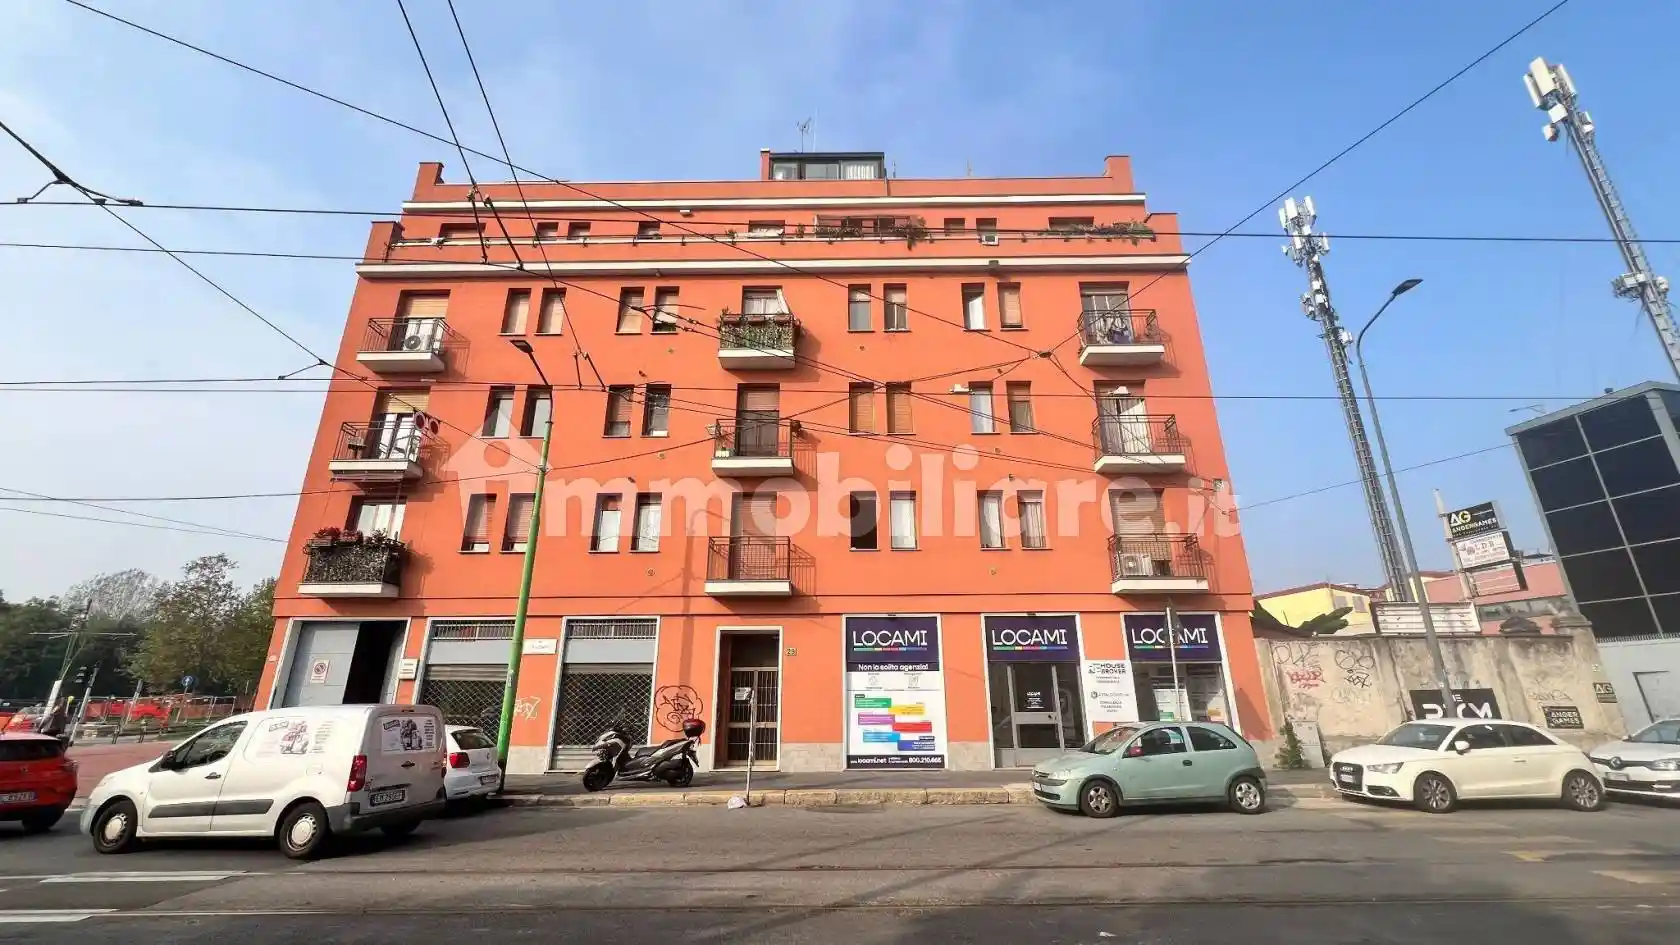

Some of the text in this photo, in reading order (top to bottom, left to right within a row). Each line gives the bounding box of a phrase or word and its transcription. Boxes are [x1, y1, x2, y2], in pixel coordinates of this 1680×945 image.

[1450, 510, 1471, 527] AG
[852, 630, 928, 646] LOCAMI
[991, 629, 1068, 645] LOCAMI
[858, 663, 872, 671] Non
